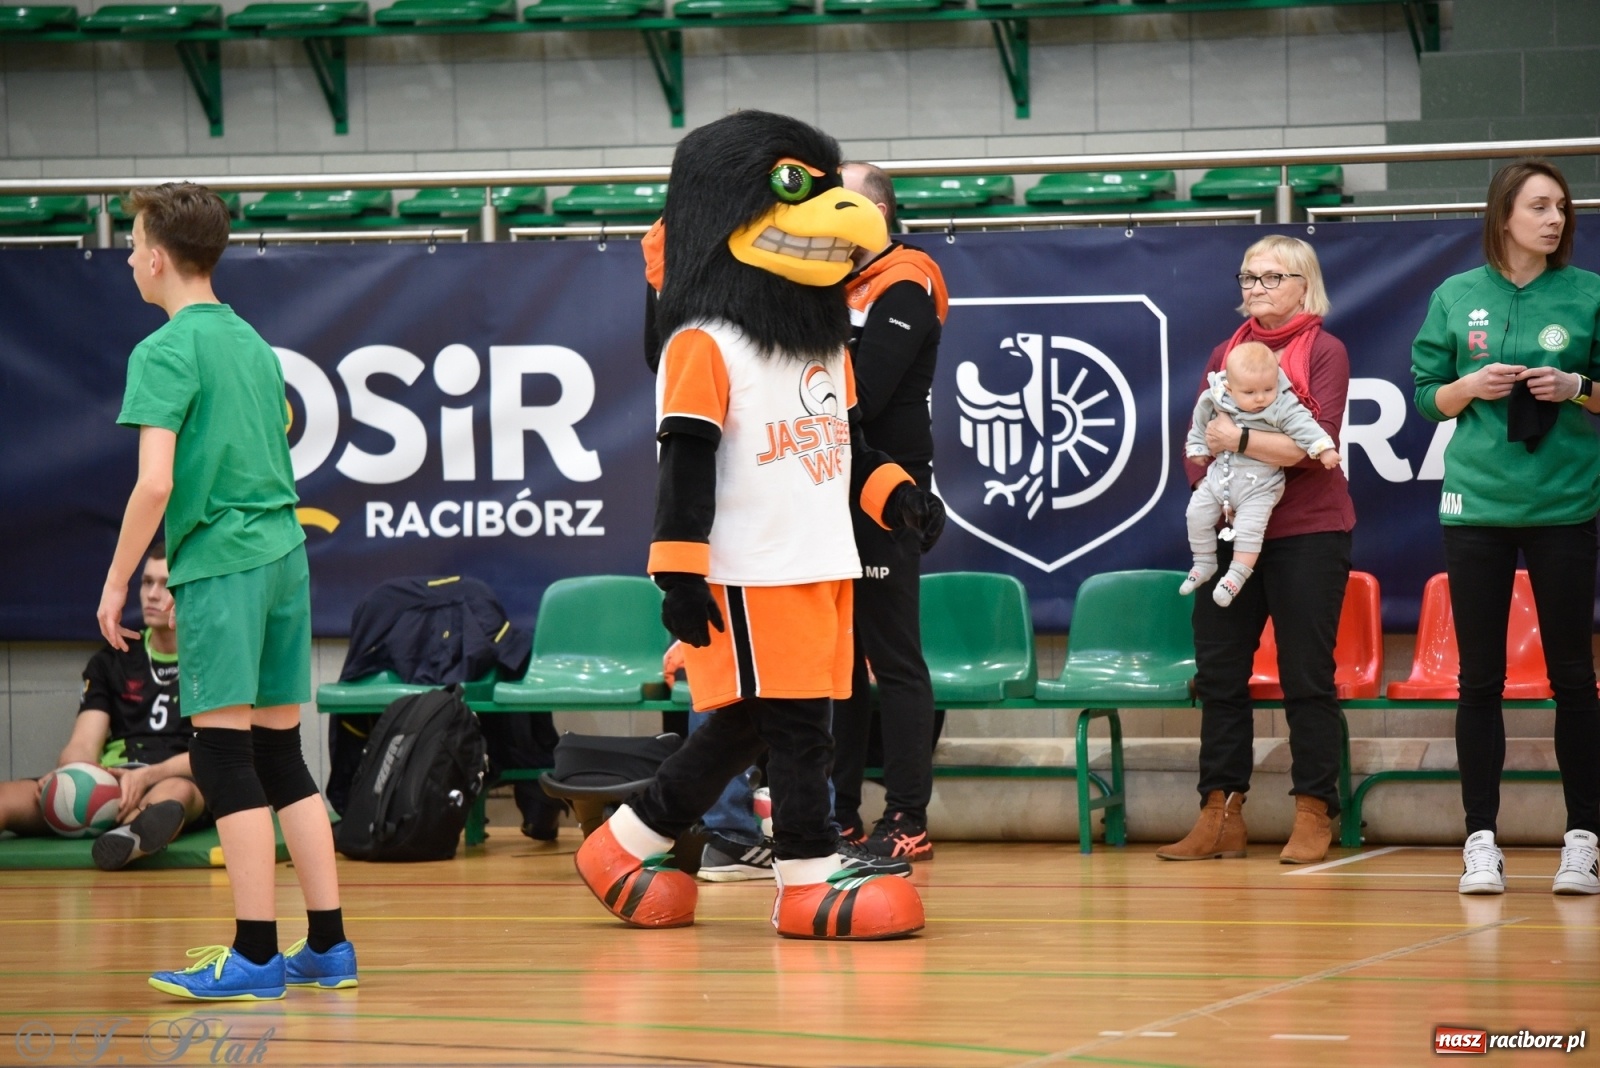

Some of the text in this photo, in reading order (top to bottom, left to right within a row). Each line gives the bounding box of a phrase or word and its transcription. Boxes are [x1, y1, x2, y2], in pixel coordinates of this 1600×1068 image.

[1468, 330, 1489, 351] R
[366, 487, 605, 539] RACIBÓRZ
[1440, 491, 1463, 515] MM
[865, 565, 890, 579] MP
[149, 693, 170, 731] 5
